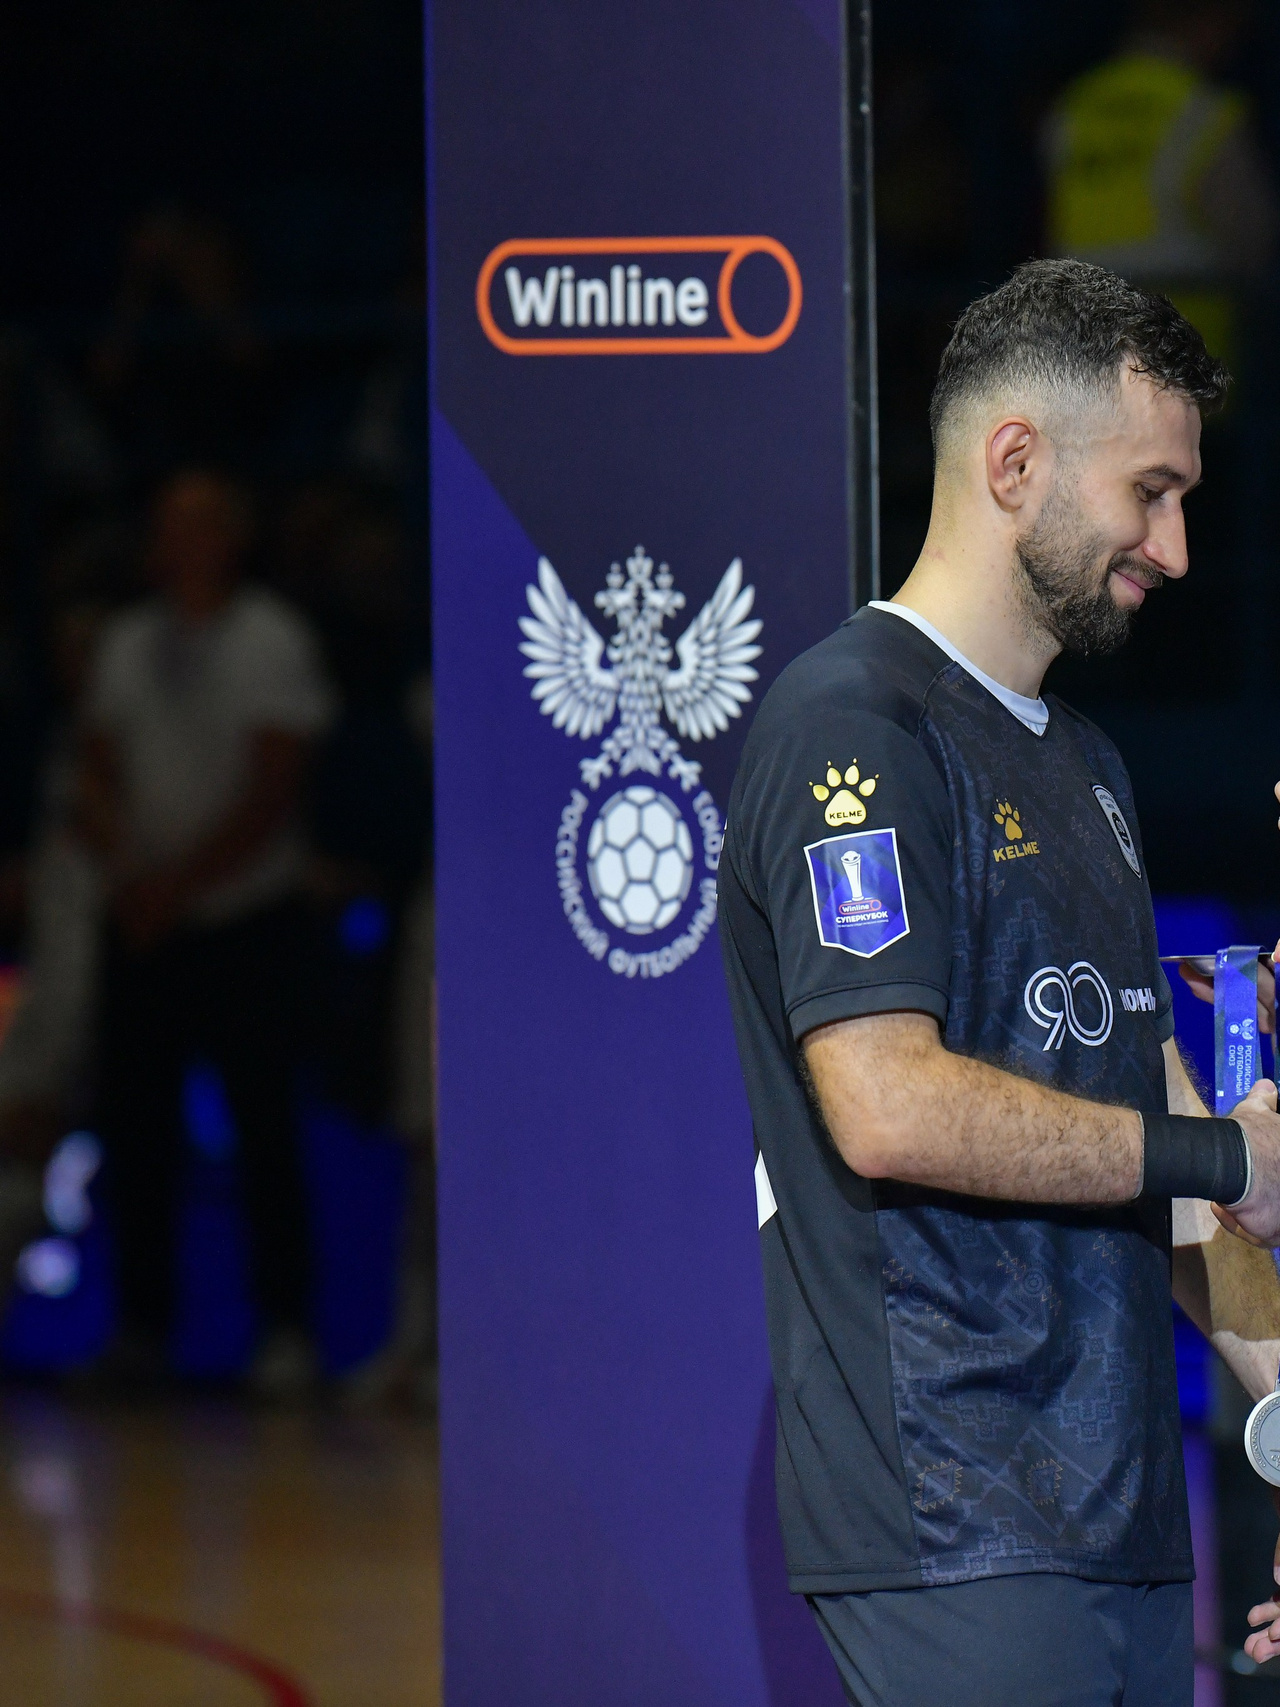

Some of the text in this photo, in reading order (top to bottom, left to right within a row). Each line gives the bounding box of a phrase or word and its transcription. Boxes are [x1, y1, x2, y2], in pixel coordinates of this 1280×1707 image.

[504, 264, 709, 327] Winline
[829, 810, 863, 819] KELME
[993, 841, 1040, 862] KELME
[835, 911, 889, 924] СУПЕРКУБОК
[842, 904, 870, 913] Winline
[1024, 961, 1114, 1051] 90
[1236, 1045, 1244, 1096] ФУТБОЛЬНЫЙ
[1244, 1045, 1252, 1093] РОССИЙСКИЙ
